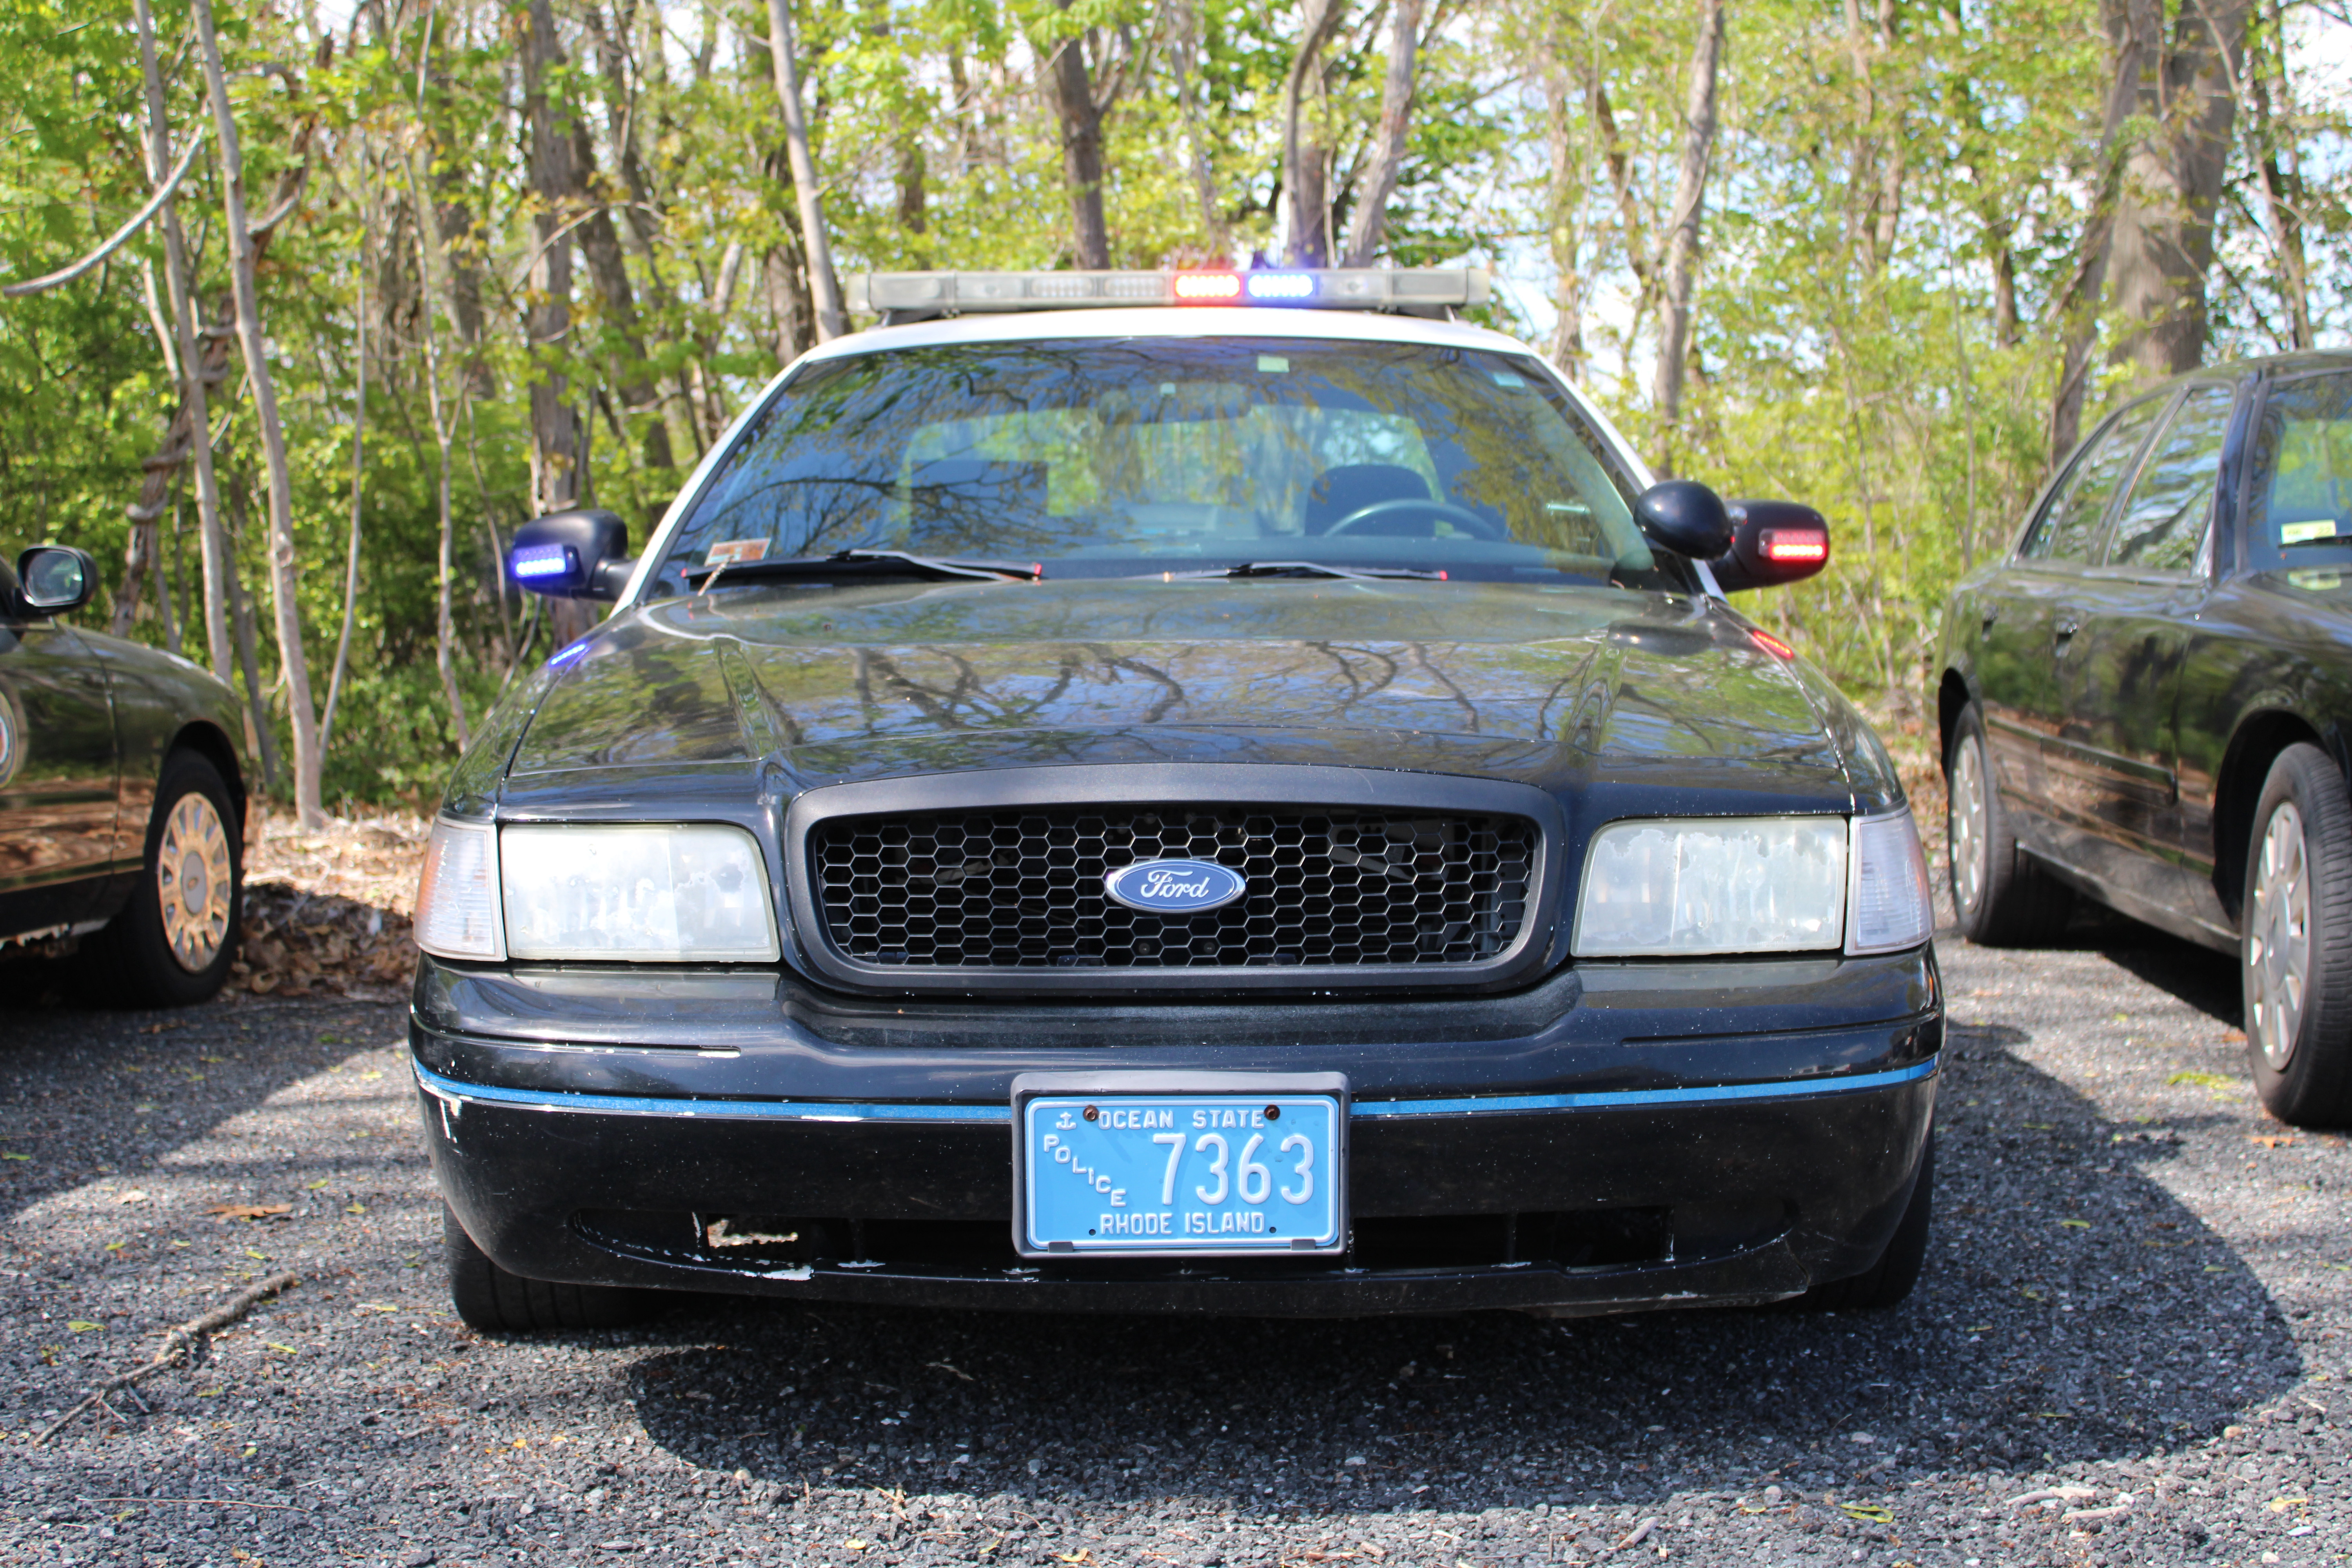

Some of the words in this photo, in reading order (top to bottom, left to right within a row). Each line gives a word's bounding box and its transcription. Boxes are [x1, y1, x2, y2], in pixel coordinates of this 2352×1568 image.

[1140, 869, 1210, 898] Ford
[1098, 1110, 1174, 1130] OCEAN
[1193, 1110, 1265, 1129] STATE
[1043, 1134, 1126, 1207] POLICE
[1152, 1133, 1314, 1205] 7363
[1100, 1212, 1173, 1235] RHODE
[1185, 1212, 1265, 1234] ISLAND
